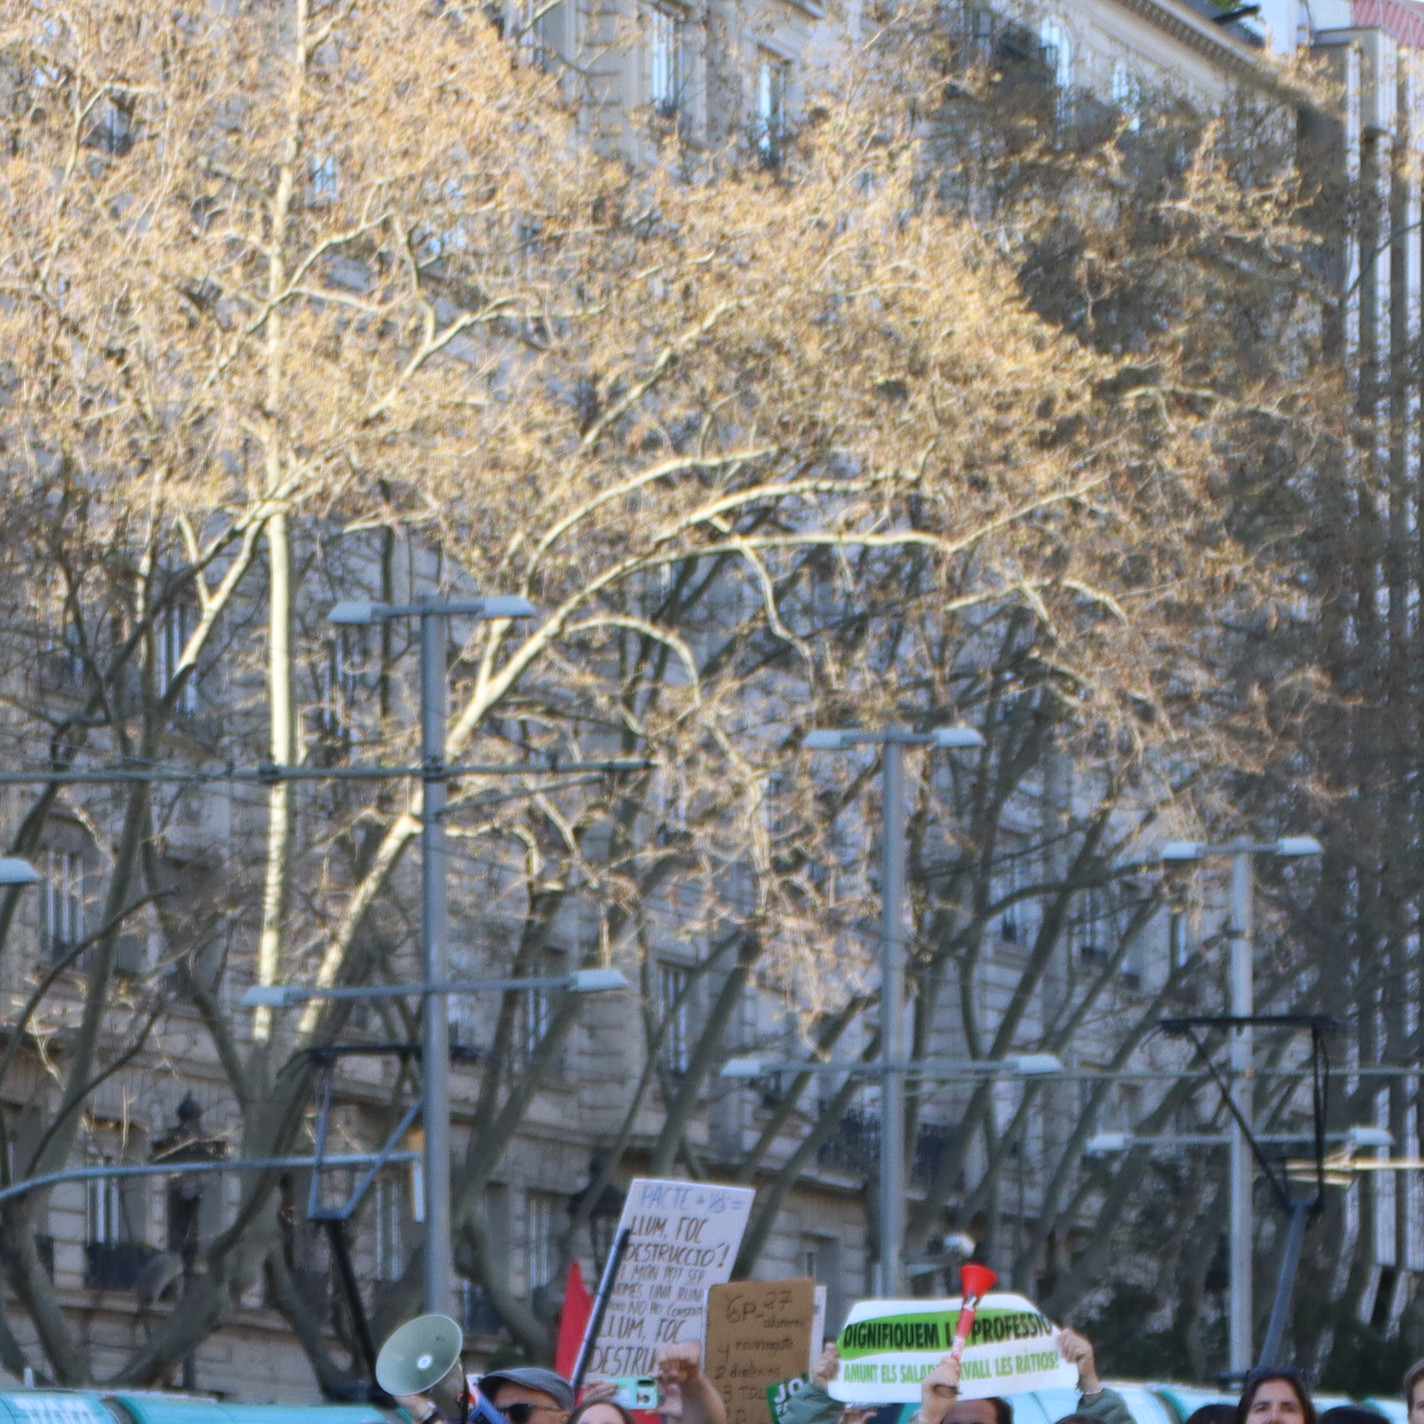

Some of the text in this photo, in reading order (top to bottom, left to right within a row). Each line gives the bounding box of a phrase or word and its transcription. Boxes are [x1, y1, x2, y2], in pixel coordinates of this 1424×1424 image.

[676, 1217, 709, 1243] FOC
[655, 1318, 686, 1344] FOC
[843, 1322, 940, 1349] DIGNIFIQUEM
[587, 1346, 657, 1378] DESTRU
[843, 1363, 878, 1383] AMUNT
[881, 1364, 898, 1383] ELS
[995, 1357, 1013, 1377] LES
